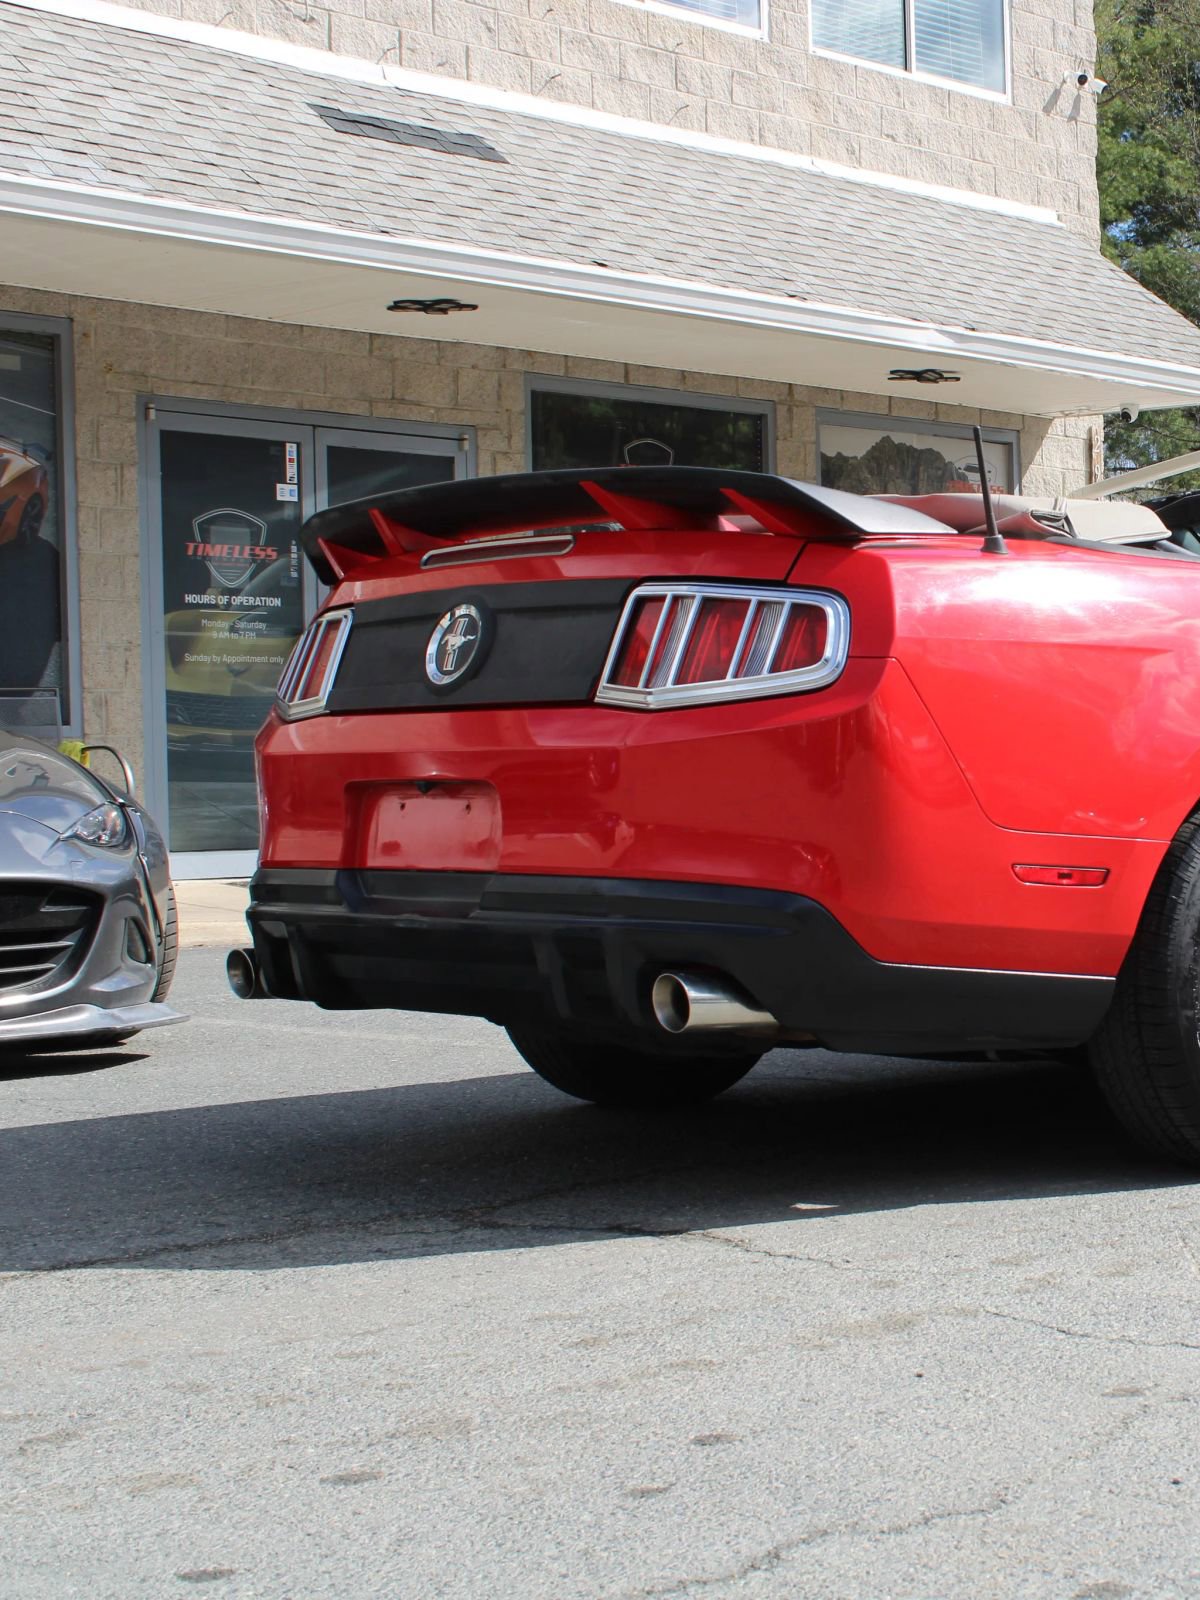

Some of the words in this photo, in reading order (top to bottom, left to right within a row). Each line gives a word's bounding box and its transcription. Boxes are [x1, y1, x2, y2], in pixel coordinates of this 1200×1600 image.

[184, 542, 280, 559] TIMELESS
[184, 594, 216, 604] HOURS
[218, 595, 230, 605] OF
[231, 596, 281, 607] OPERATION
[201, 619, 229, 630] Monday
[234, 620, 267, 630] Saturday
[219, 631, 230, 639] AM
[230, 631, 239, 640] to
[239, 631, 245, 640] 7
[245, 631, 256, 640] PM
[184, 653, 212, 663] Sunday
[212, 654, 221, 664] by
[222, 654, 268, 664] Appointment
[269, 656, 285, 665] only
